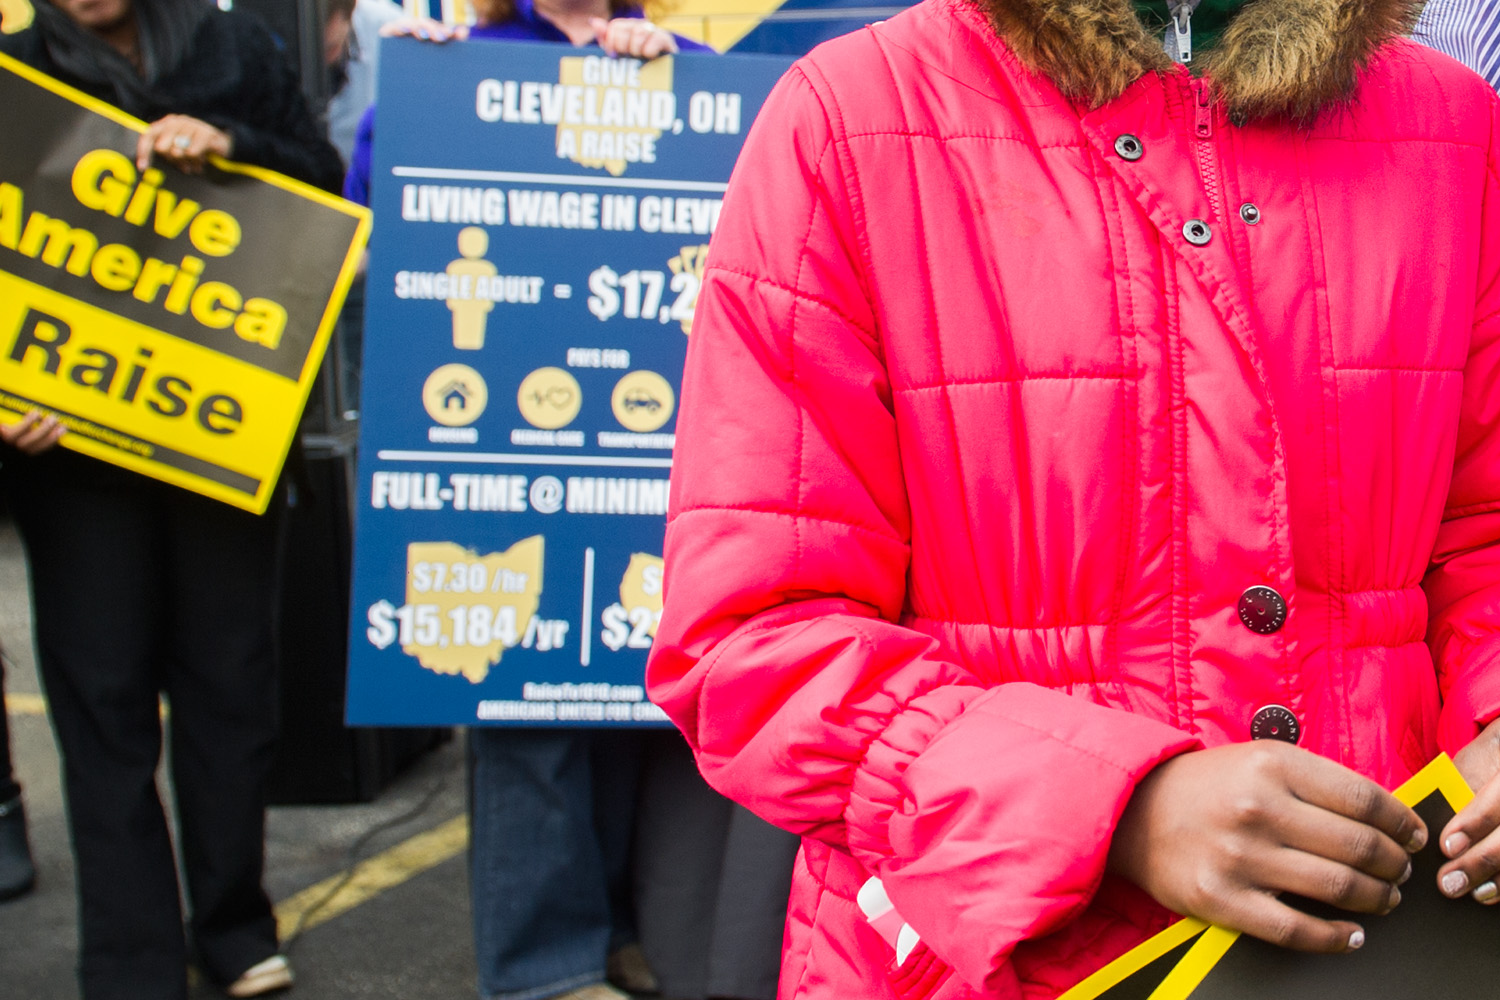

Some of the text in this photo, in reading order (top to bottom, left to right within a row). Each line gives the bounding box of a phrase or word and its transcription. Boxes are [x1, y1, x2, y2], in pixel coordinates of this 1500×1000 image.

[583, 55, 642, 87] GIVE
[476, 78, 742, 135] CLEVELAND, OH
[556, 128, 657, 163] A RAISE
[71, 148, 242, 258] Give
[402, 184, 505, 226] LIVING
[508, 188, 599, 230] WAGE
[601, 193, 636, 231] IN
[395, 270, 473, 301] SINGLE
[474, 274, 544, 304] ADULT
[5, 306, 244, 435] Raise
[371, 471, 528, 512] FULL-TIME
[529, 475, 565, 514] @
[411, 560, 488, 594] $7.30
[367, 599, 570, 652] $15,184 /yr
